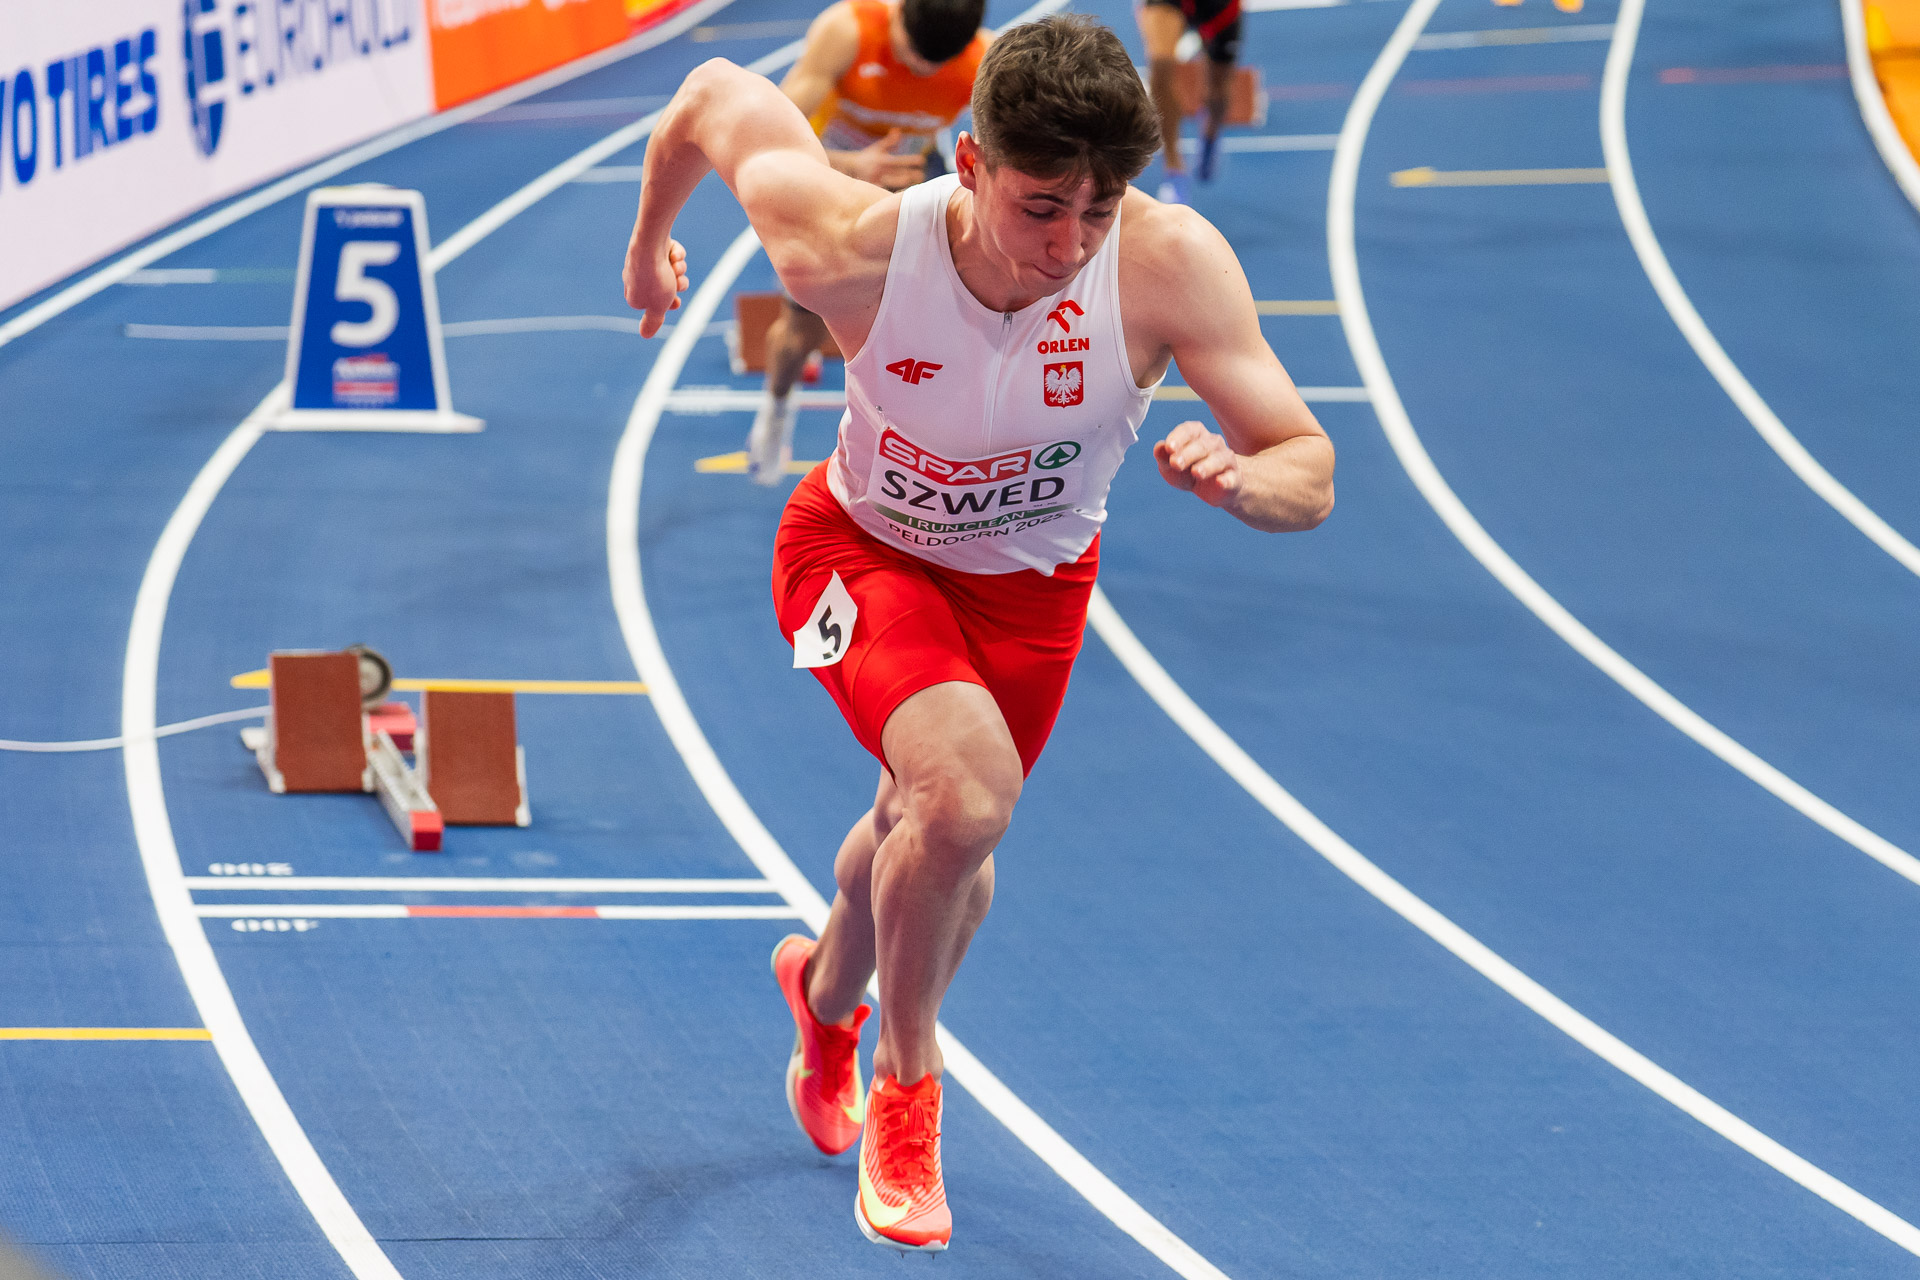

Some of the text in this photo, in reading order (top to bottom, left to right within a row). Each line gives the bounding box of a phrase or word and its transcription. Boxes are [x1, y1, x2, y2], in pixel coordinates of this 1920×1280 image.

[47, 28, 158, 169] TIRES
[330, 240, 401, 348] 5
[1037, 338, 1090, 354] ORLEN
[885, 357, 944, 386] 4F
[884, 437, 1027, 483] SPAR
[881, 470, 1065, 515] SZWED
[880, 516, 1010, 547] PELDOORN
[908, 517, 913, 526] I
[917, 520, 959, 533] RUN
[817, 604, 842, 660] 5
